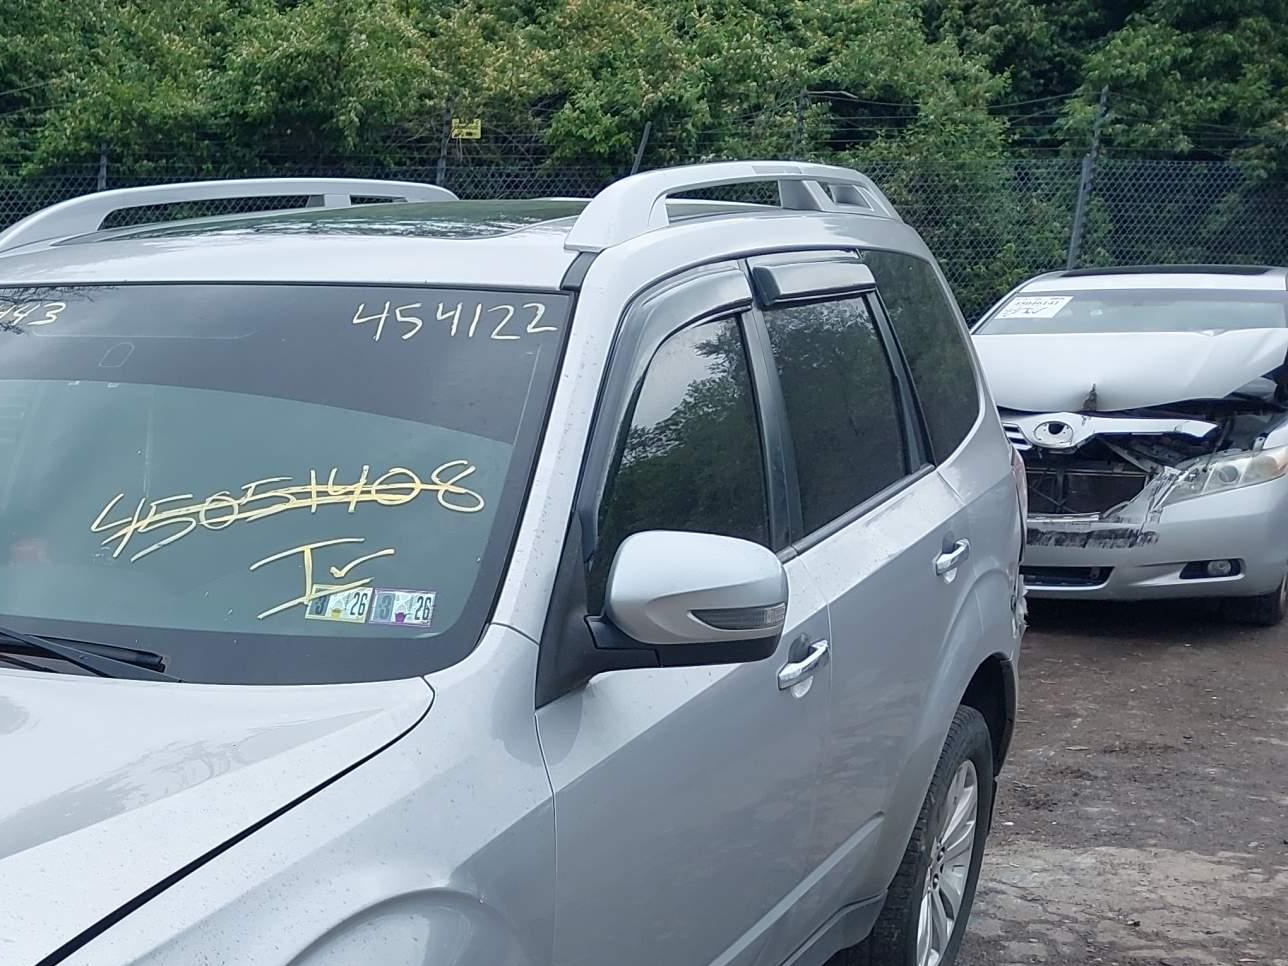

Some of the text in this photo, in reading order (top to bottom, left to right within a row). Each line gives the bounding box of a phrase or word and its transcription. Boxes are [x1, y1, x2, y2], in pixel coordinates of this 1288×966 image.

[352, 301, 558, 341] 454122
[349, 592, 368, 616] 26
[414, 596, 432, 620] 26
